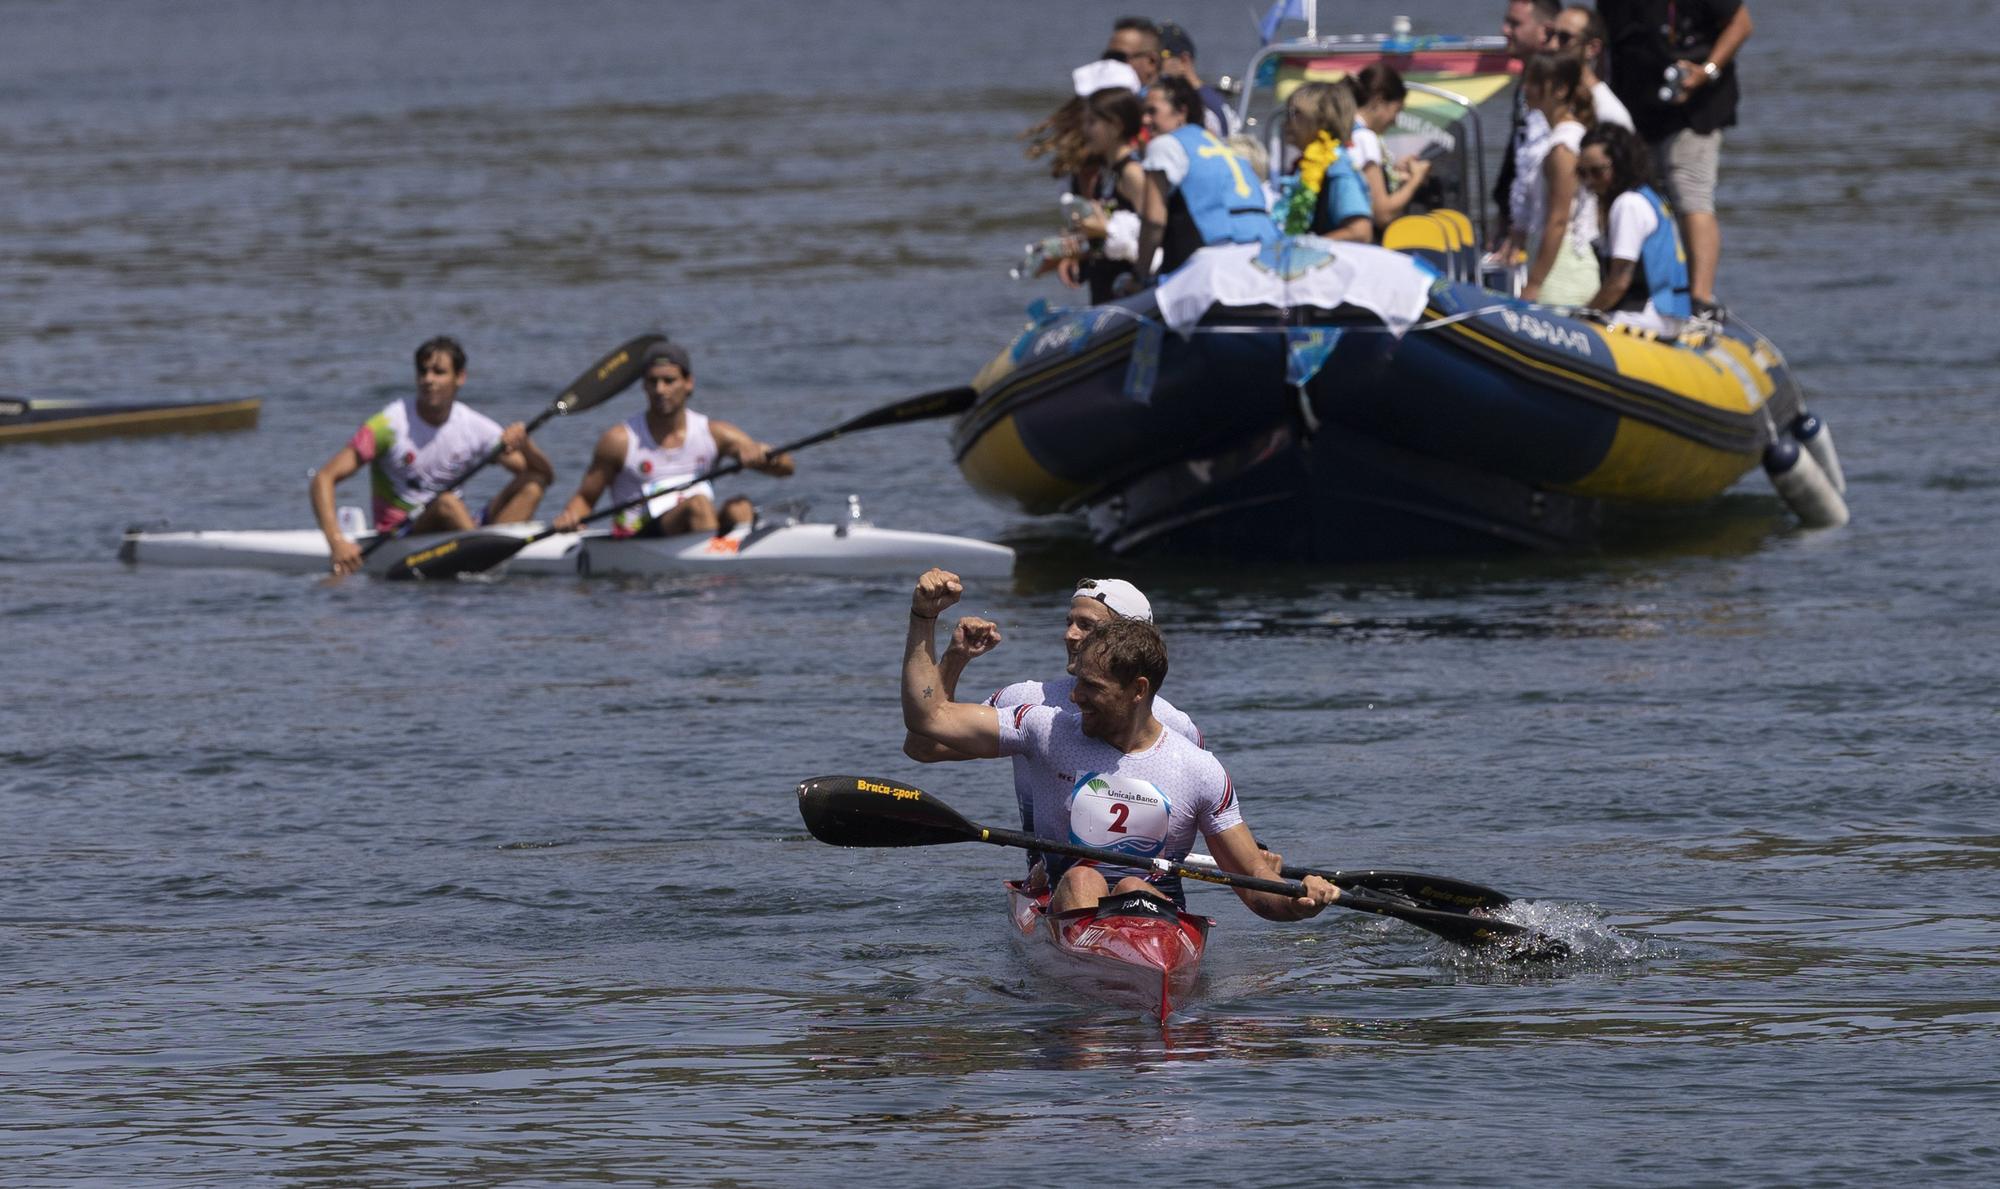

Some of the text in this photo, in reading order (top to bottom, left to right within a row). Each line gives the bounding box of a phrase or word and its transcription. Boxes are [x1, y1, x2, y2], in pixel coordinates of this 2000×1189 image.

[1107, 789, 1159, 804] Unicaja Banco
[1107, 802, 1130, 834] 2
[1121, 898, 1159, 913] FRANCE
